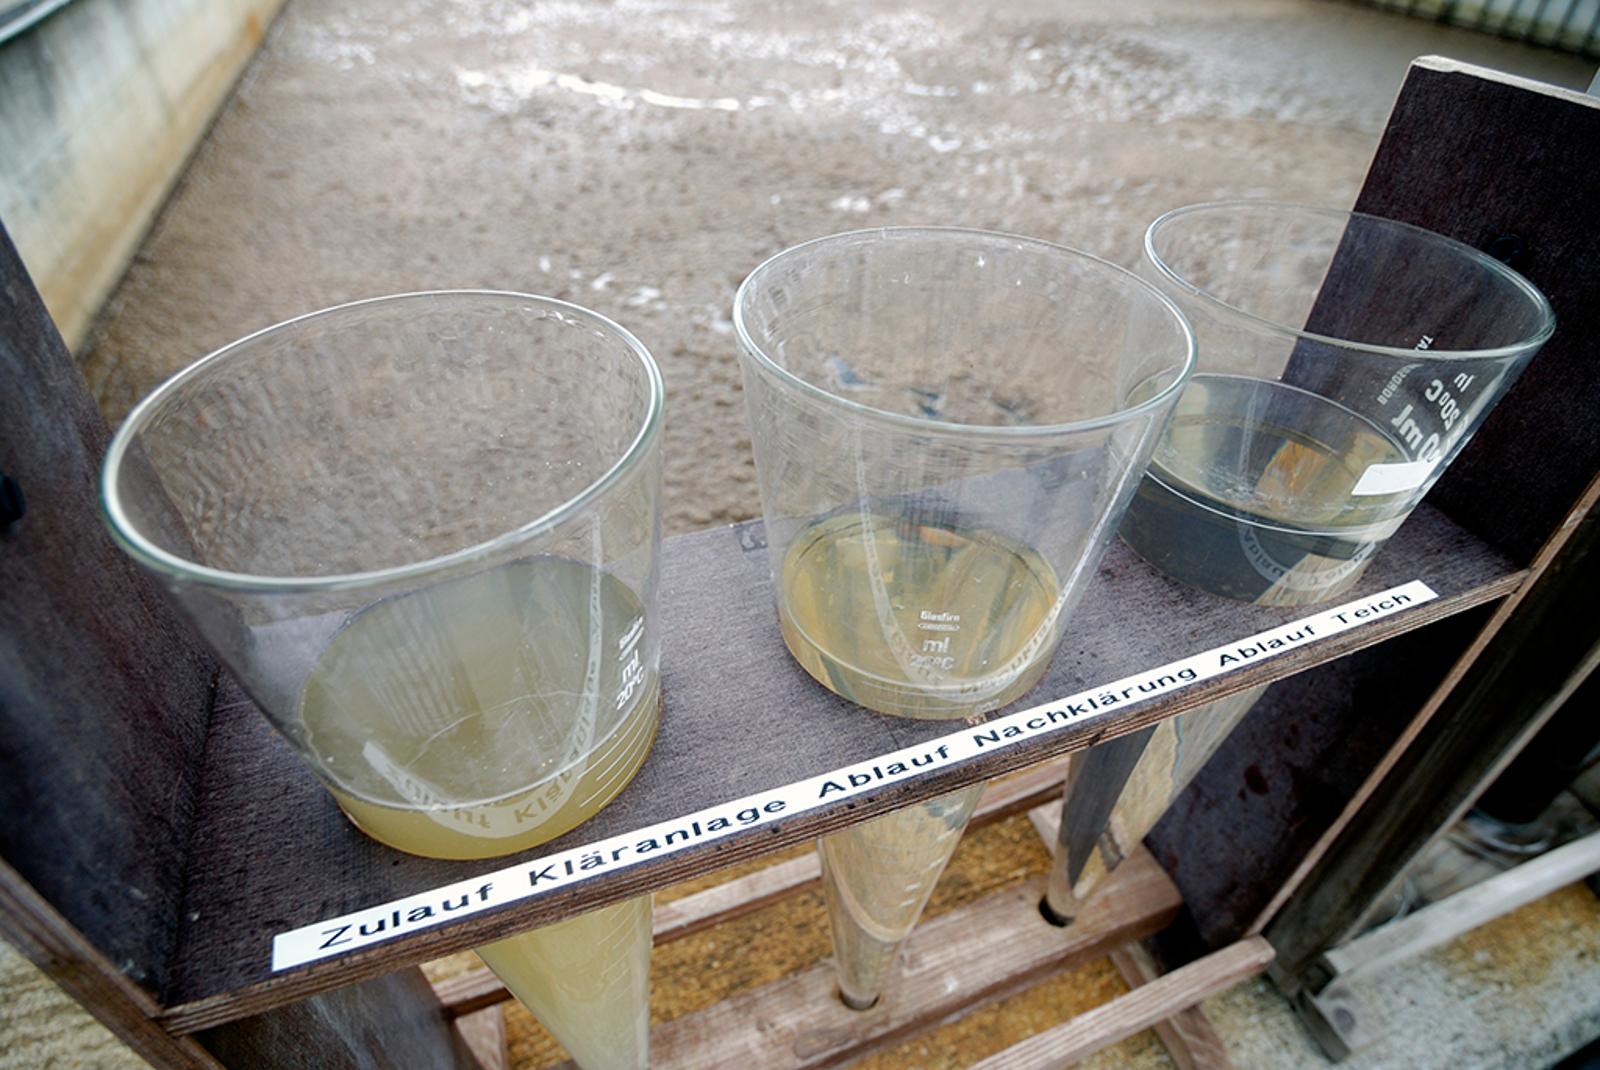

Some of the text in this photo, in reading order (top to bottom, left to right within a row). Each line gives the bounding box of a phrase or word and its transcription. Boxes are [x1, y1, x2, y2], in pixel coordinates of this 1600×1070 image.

[923, 637, 950, 653] ml
[318, 591, 1412, 950] Zulauf Kläranlage Ablauf Nachklärung Ablauf Teich
